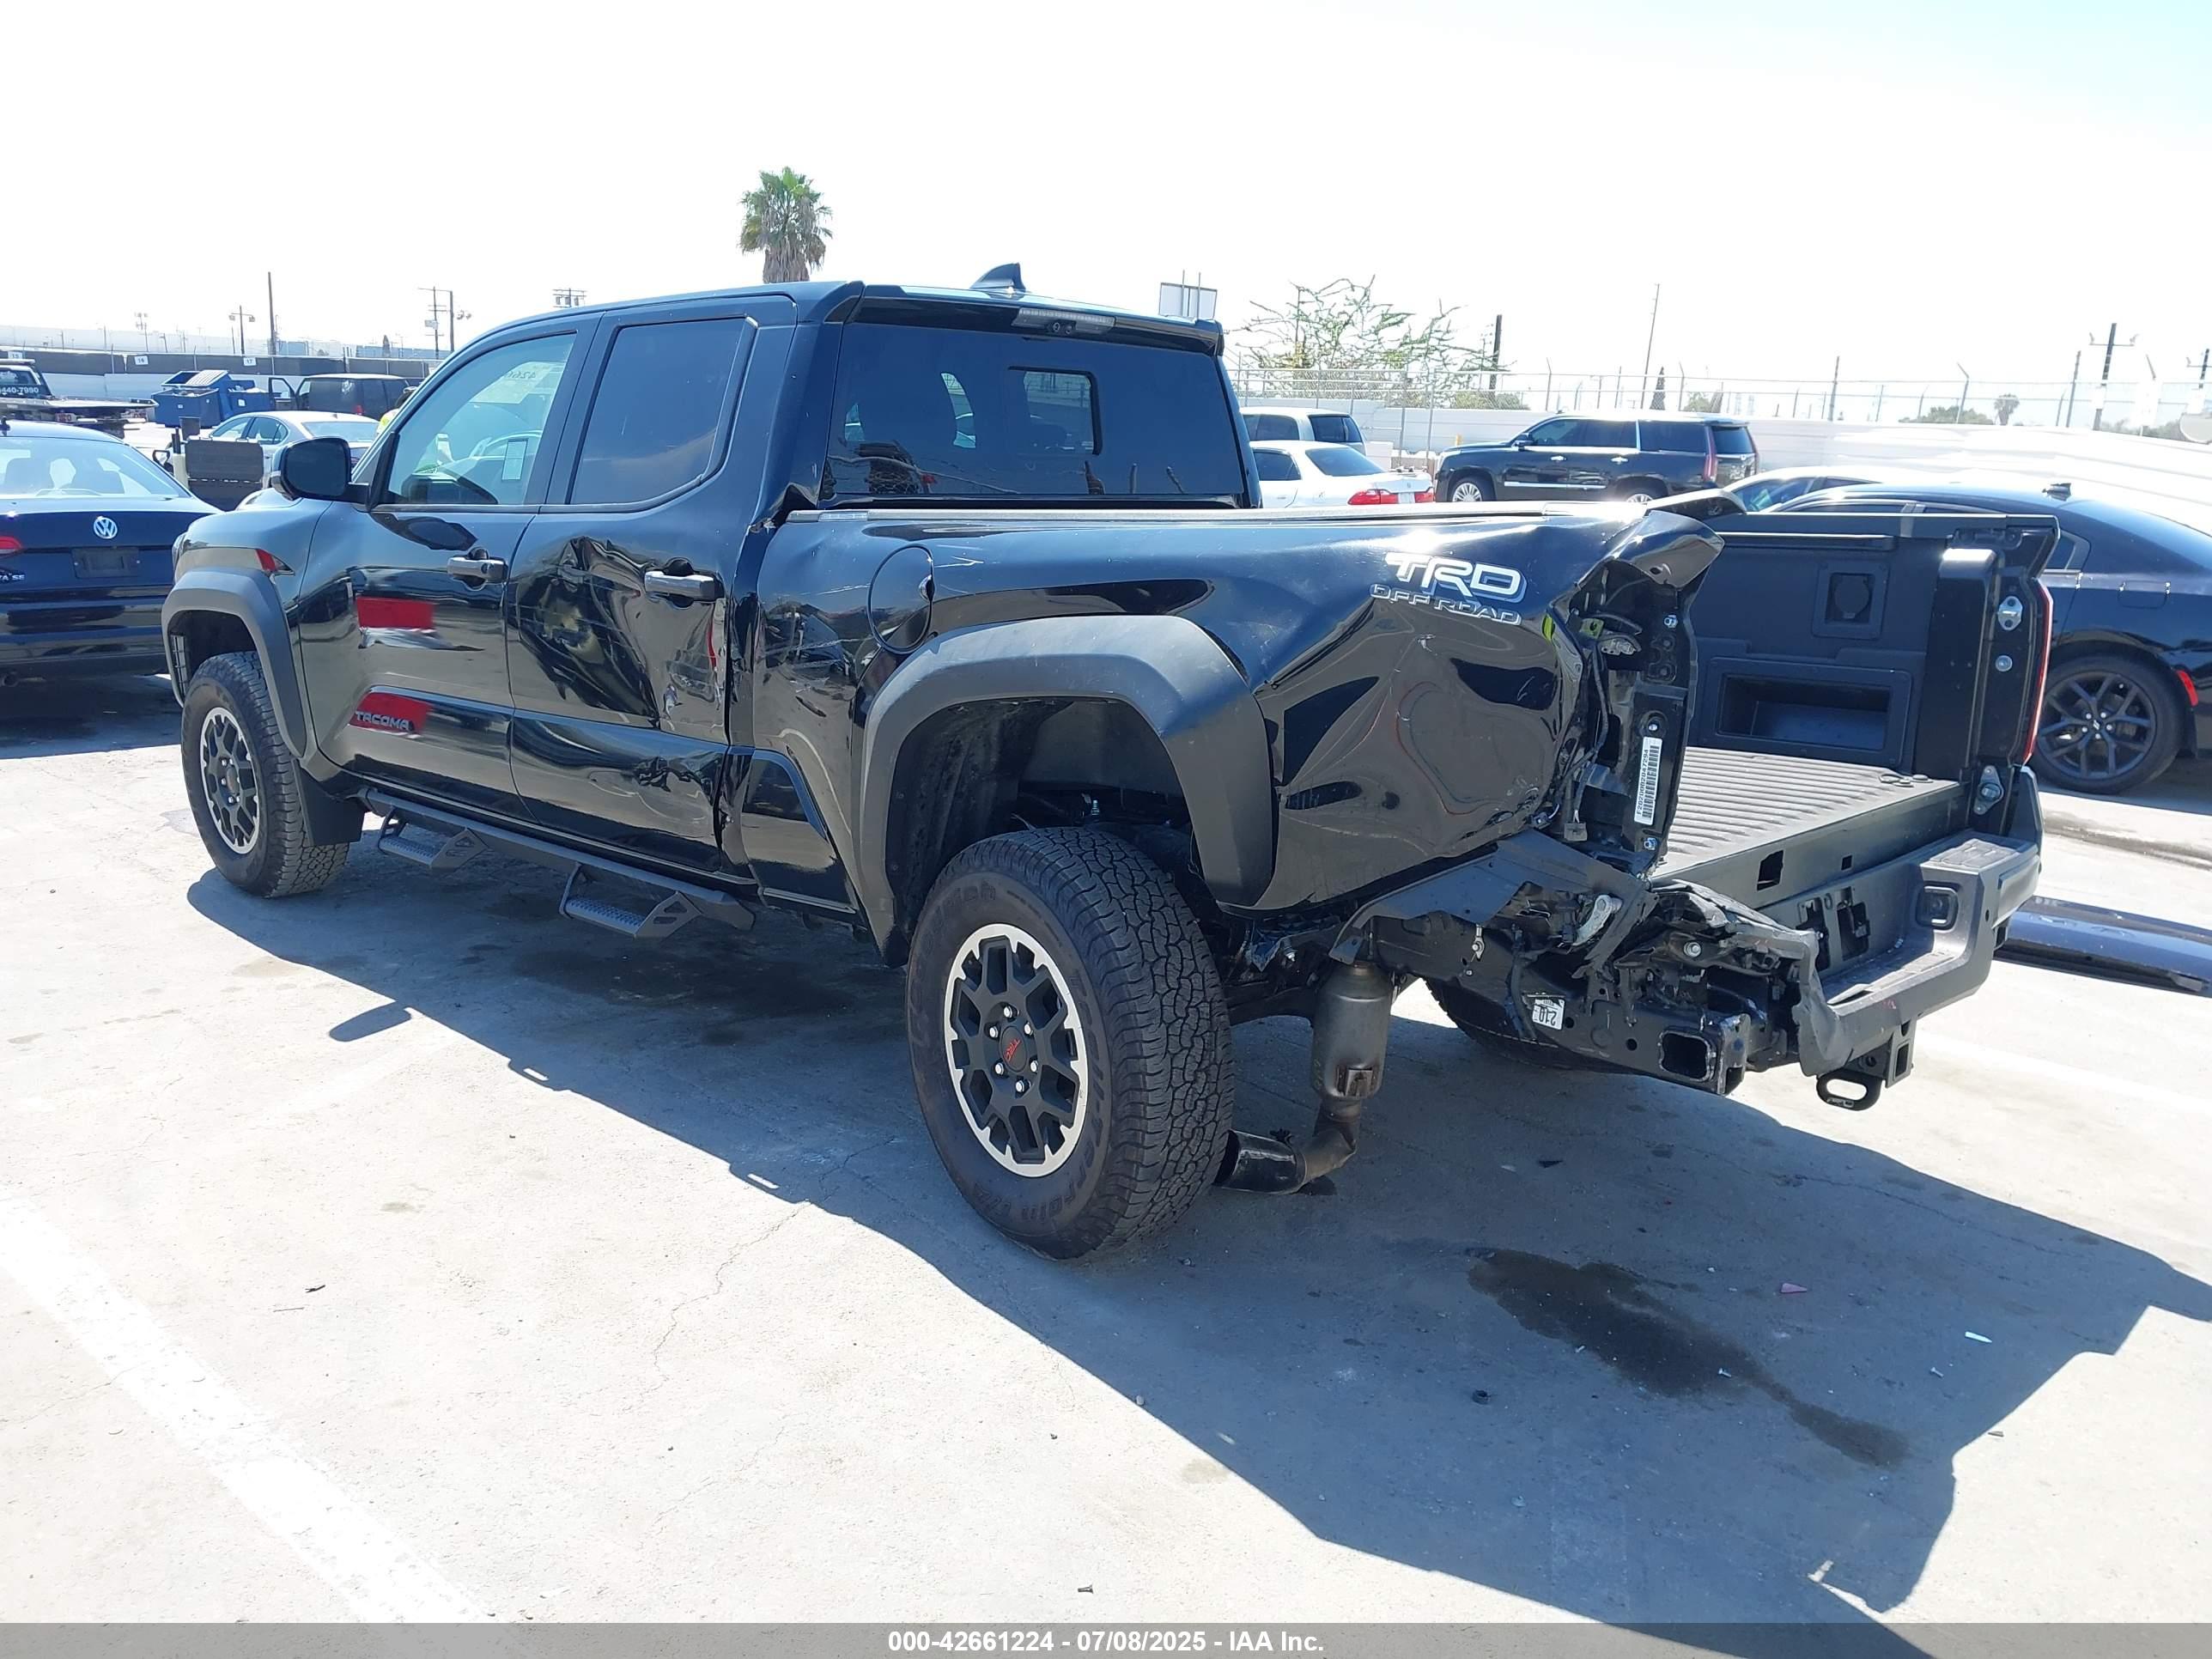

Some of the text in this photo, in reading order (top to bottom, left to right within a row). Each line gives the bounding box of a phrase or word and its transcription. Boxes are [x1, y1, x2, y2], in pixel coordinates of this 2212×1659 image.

[1384, 551, 1525, 601] TRD
[1370, 583, 1522, 626] OFF ROAD
[356, 711, 410, 731] TACOMA
